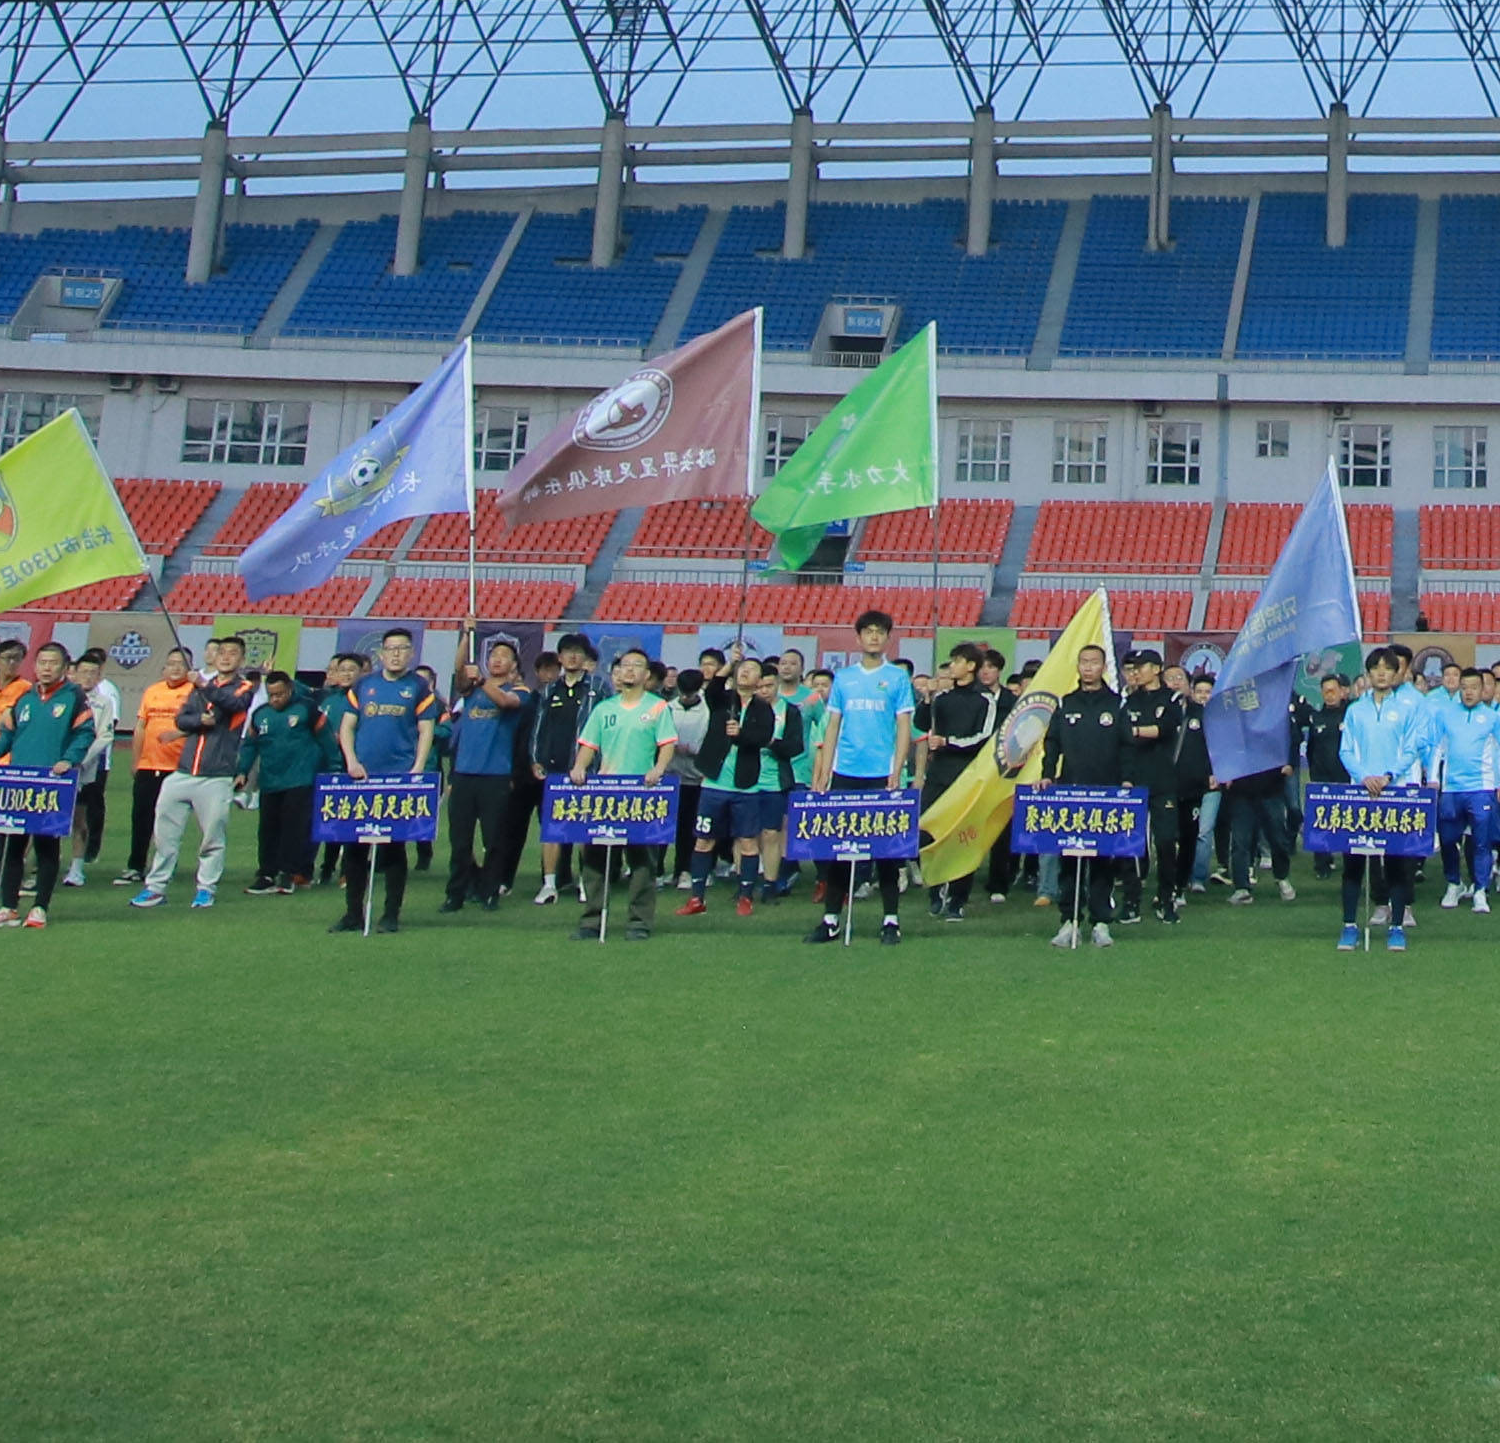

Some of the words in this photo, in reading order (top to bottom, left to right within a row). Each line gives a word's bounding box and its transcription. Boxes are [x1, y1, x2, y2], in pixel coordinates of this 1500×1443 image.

[603, 714, 617, 730] 10
[320, 794, 431, 821] 长治金盾足球队
[1025, 806, 1136, 837] 聚诚足球俱乐部
[1312, 803, 1427, 837] 兄弟连足球俱乐部
[796, 811, 912, 840] 大力水手足球俱乐部
